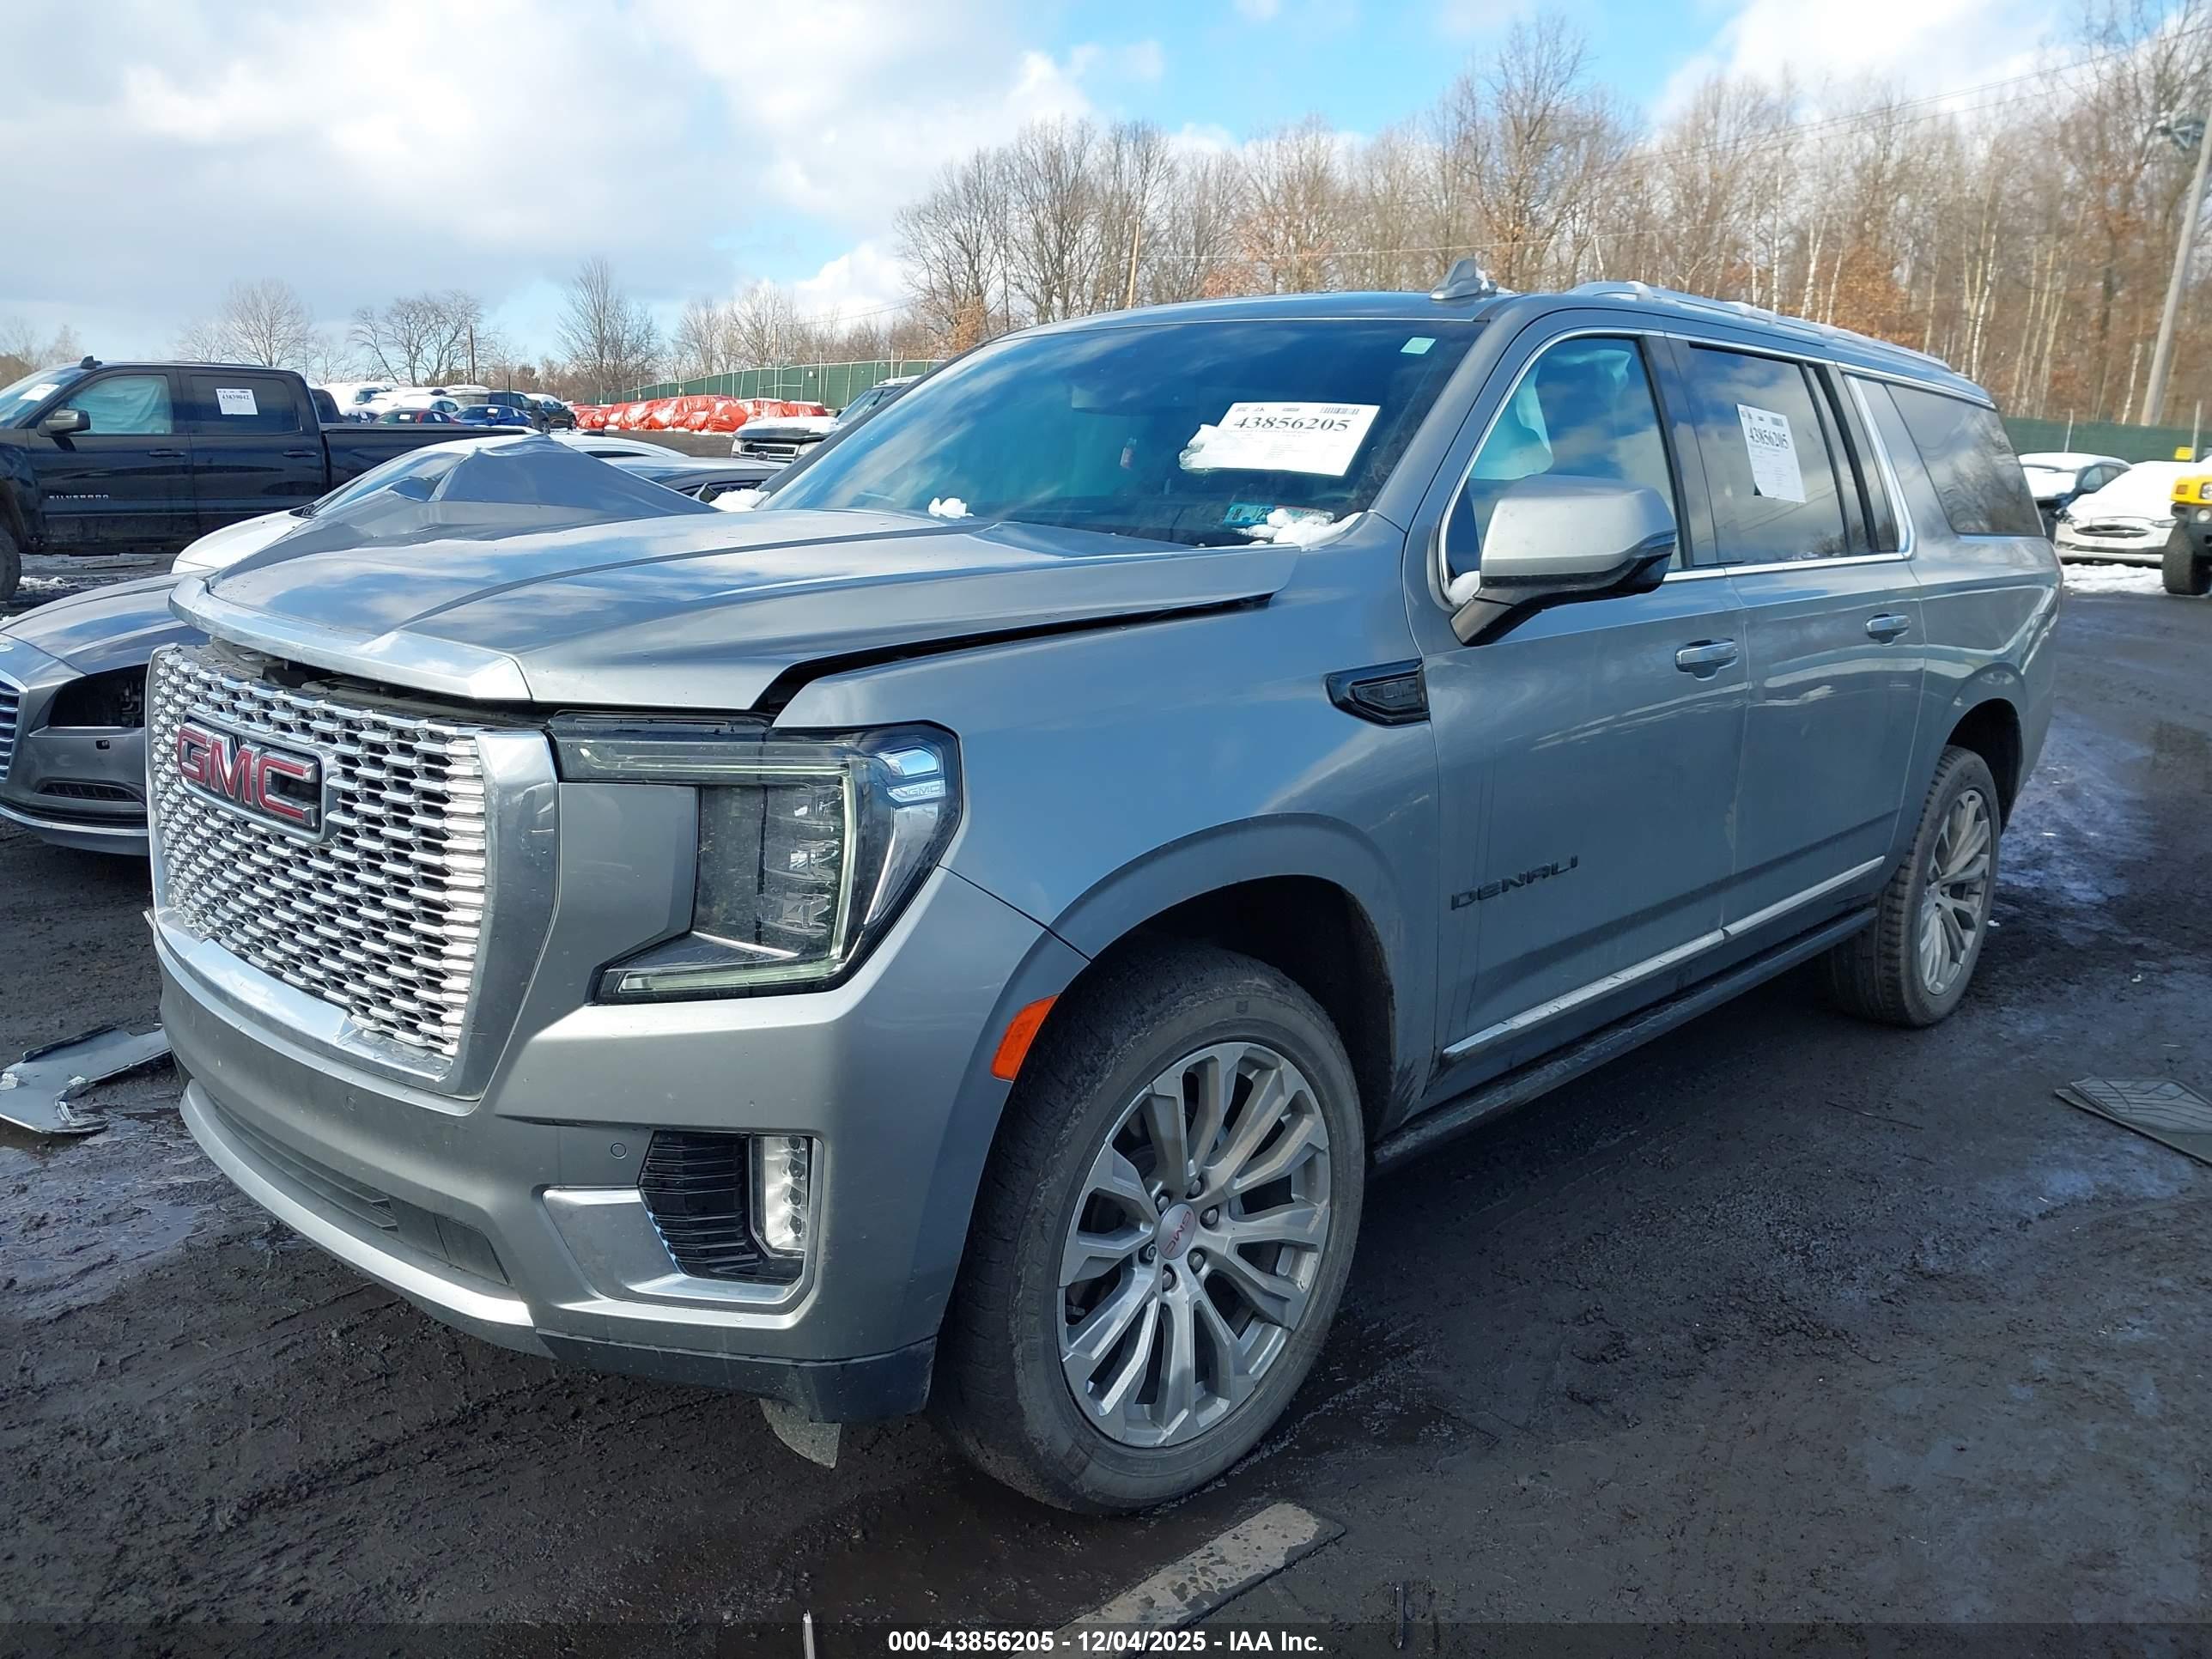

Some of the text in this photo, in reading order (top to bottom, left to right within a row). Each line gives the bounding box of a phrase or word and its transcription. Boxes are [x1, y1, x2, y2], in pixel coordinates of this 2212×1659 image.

[1233, 416, 1351, 432] 43856205
[177, 723, 321, 828] GMC
[1450, 855, 1578, 911] DENALI
[1164, 1210, 1191, 1254] GMC
